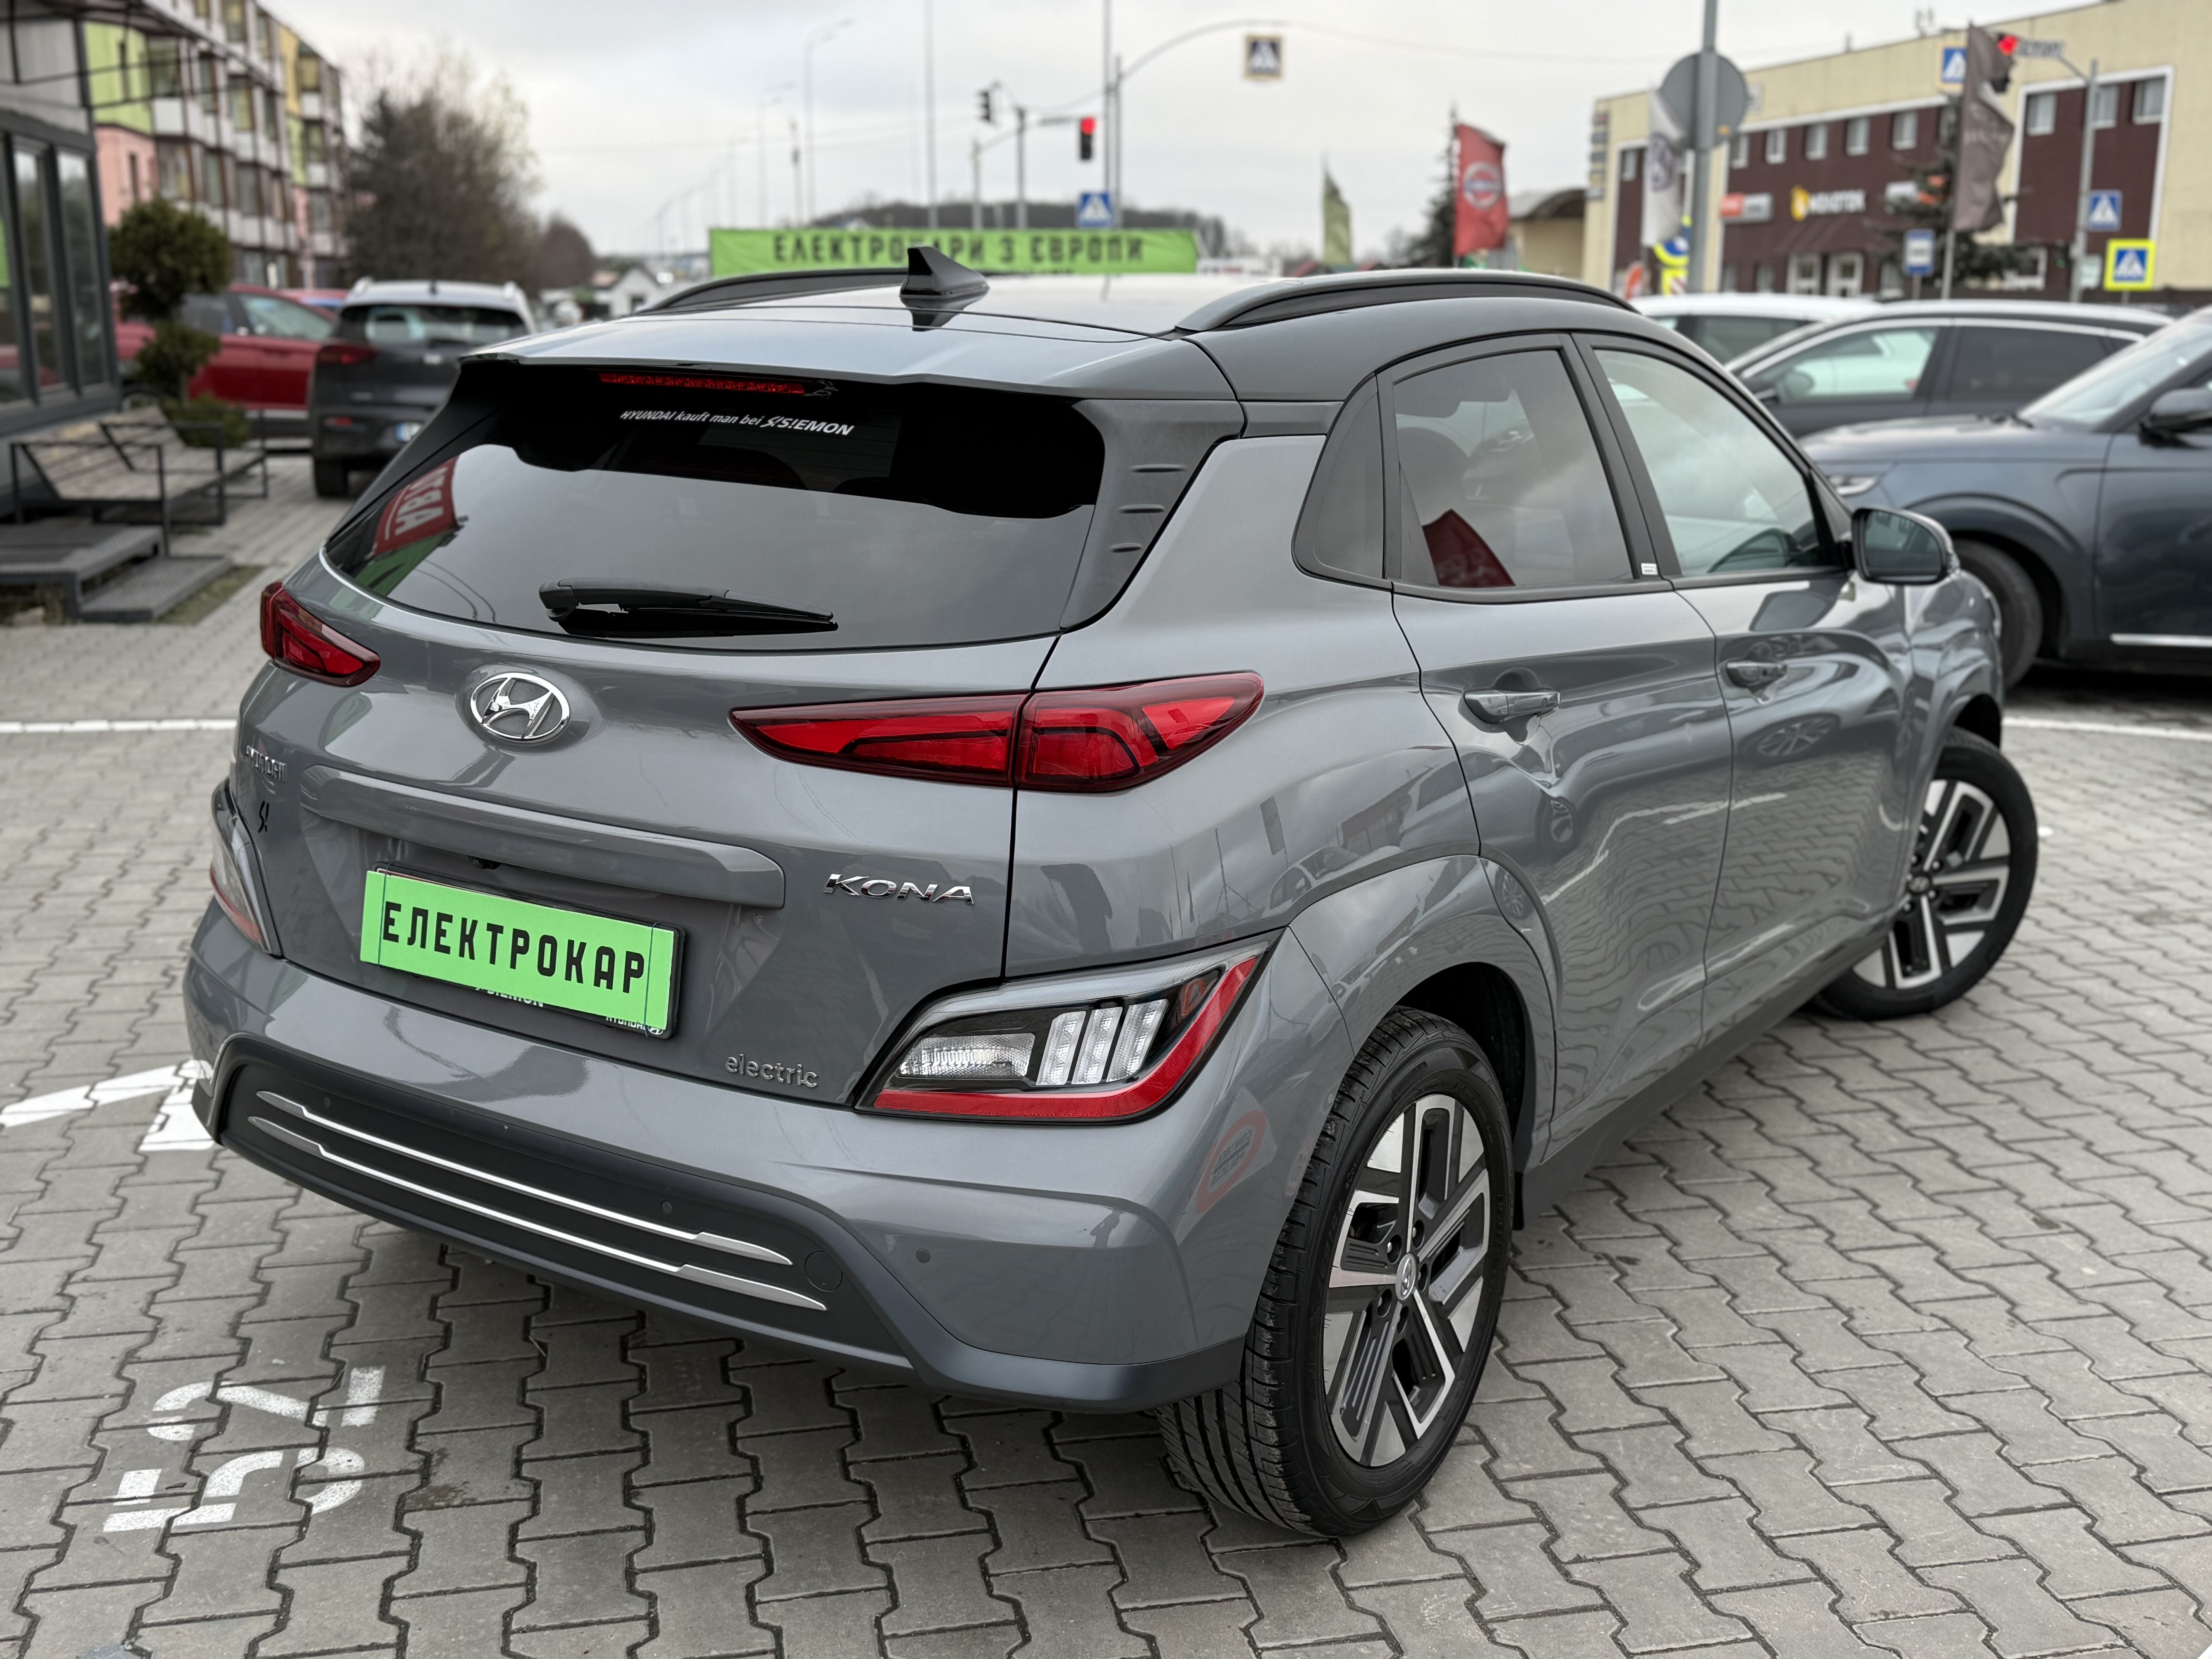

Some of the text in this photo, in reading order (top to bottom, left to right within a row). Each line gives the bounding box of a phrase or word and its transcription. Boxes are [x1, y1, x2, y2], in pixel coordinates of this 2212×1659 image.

[773, 235, 984, 263] ЕЛЕКТРОРИ
[620, 410, 676, 420] HYUNDAI
[674, 411, 711, 422] kauft
[709, 414, 738, 424] man
[739, 414, 765, 425] bei
[823, 873, 974, 905] KONA
[383, 901, 645, 994] ЕЛЕКТРОКАР
[725, 1054, 818, 1088] electric
